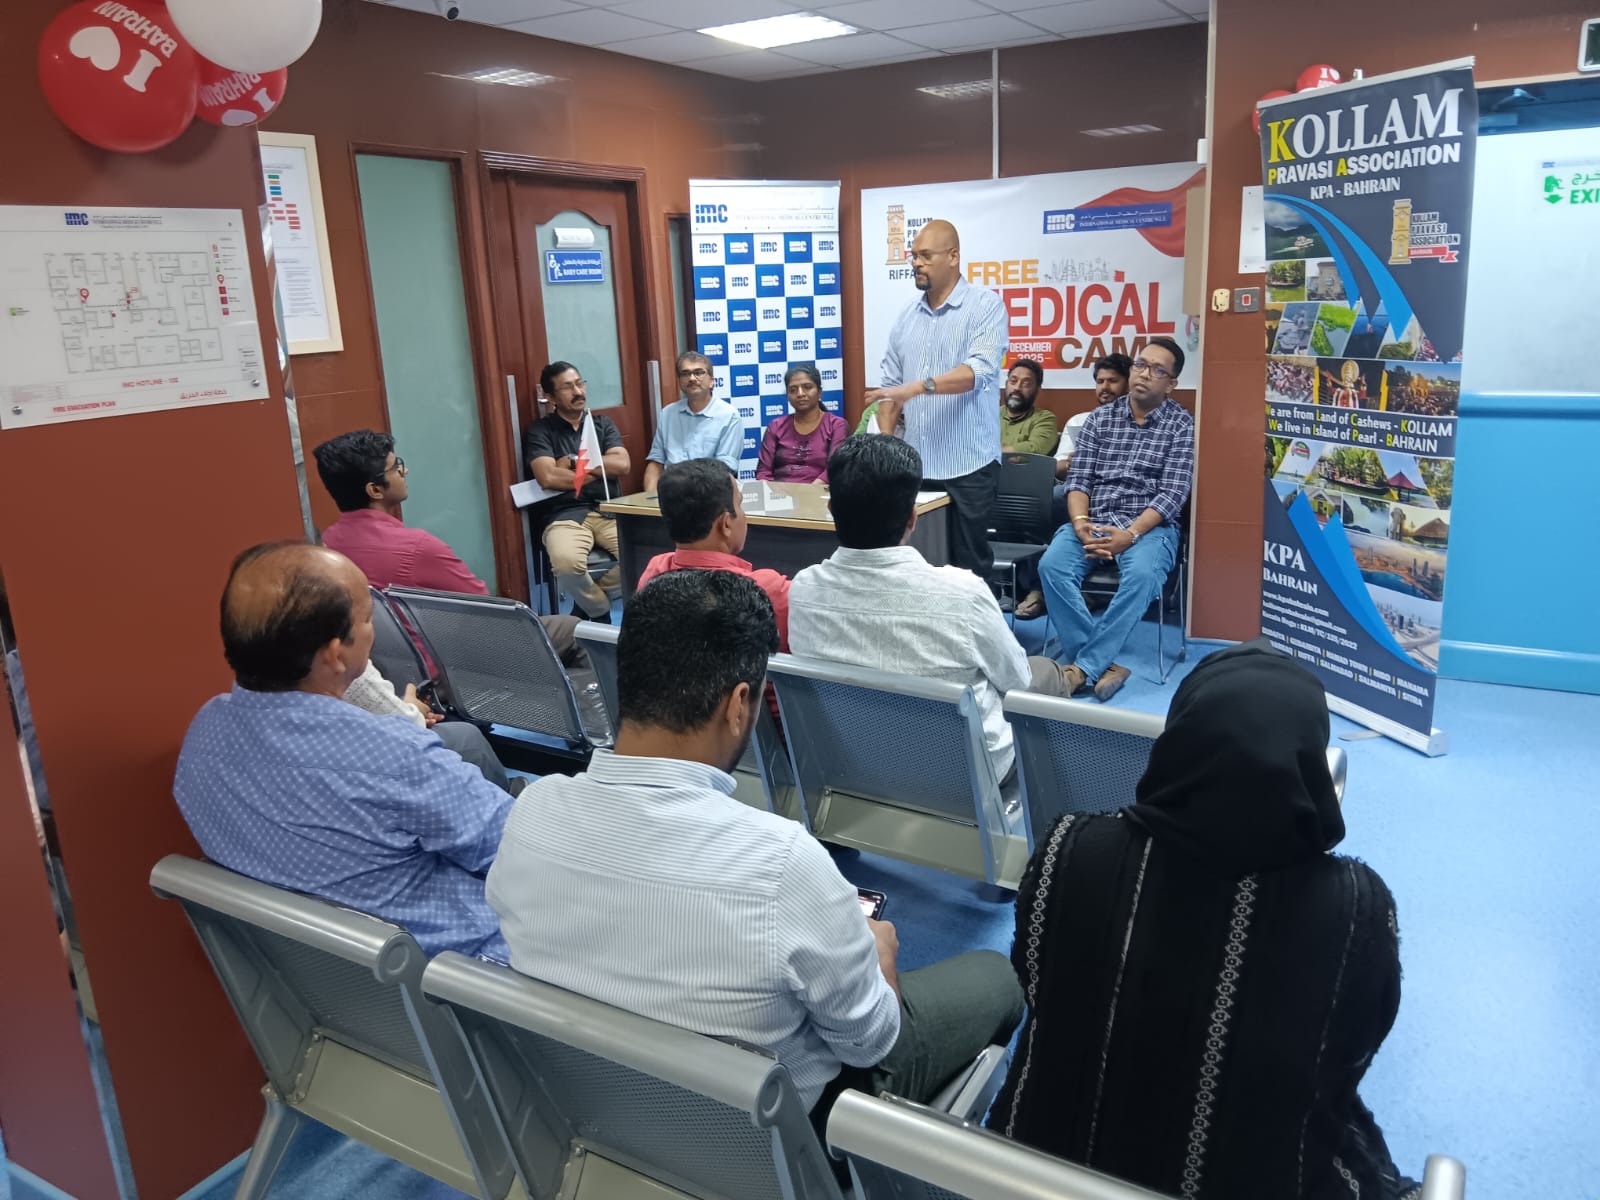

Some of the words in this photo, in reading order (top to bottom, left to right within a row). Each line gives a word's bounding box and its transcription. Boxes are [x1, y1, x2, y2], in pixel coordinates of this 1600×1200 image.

[93, 0, 178, 59] BAHRAIN
[123, 49, 162, 92] I
[1267, 88, 1463, 163] KOLLAM
[1268, 160, 1333, 186] PRAVASI
[1336, 142, 1460, 177] ASSOCIATION
[1310, 185, 1334, 200] KPA
[1343, 176, 1401, 197] BAHRAIN
[1571, 189, 1600, 204] EXI
[695, 204, 728, 223] imc
[967, 259, 1039, 286] FREE
[990, 282, 1176, 337] EDICAL
[1009, 341, 1052, 353] DECEMBER
[1268, 419, 1283, 431] We
[1284, 422, 1302, 434] live
[1302, 423, 1311, 435] in
[1312, 424, 1338, 439] Island
[1340, 427, 1350, 440] of
[1352, 429, 1377, 445] Pearl
[1386, 432, 1438, 453] BAHRAIN
[1277, 408, 1291, 418] are
[1293, 406, 1314, 420] from
[1315, 408, 1337, 424] Land
[1338, 413, 1349, 425] of
[1350, 413, 1392, 431] Cashews
[1400, 419, 1453, 437] KOLLAM
[1263, 539, 1307, 572] KPA
[1263, 567, 1318, 596] BAHRAIN
